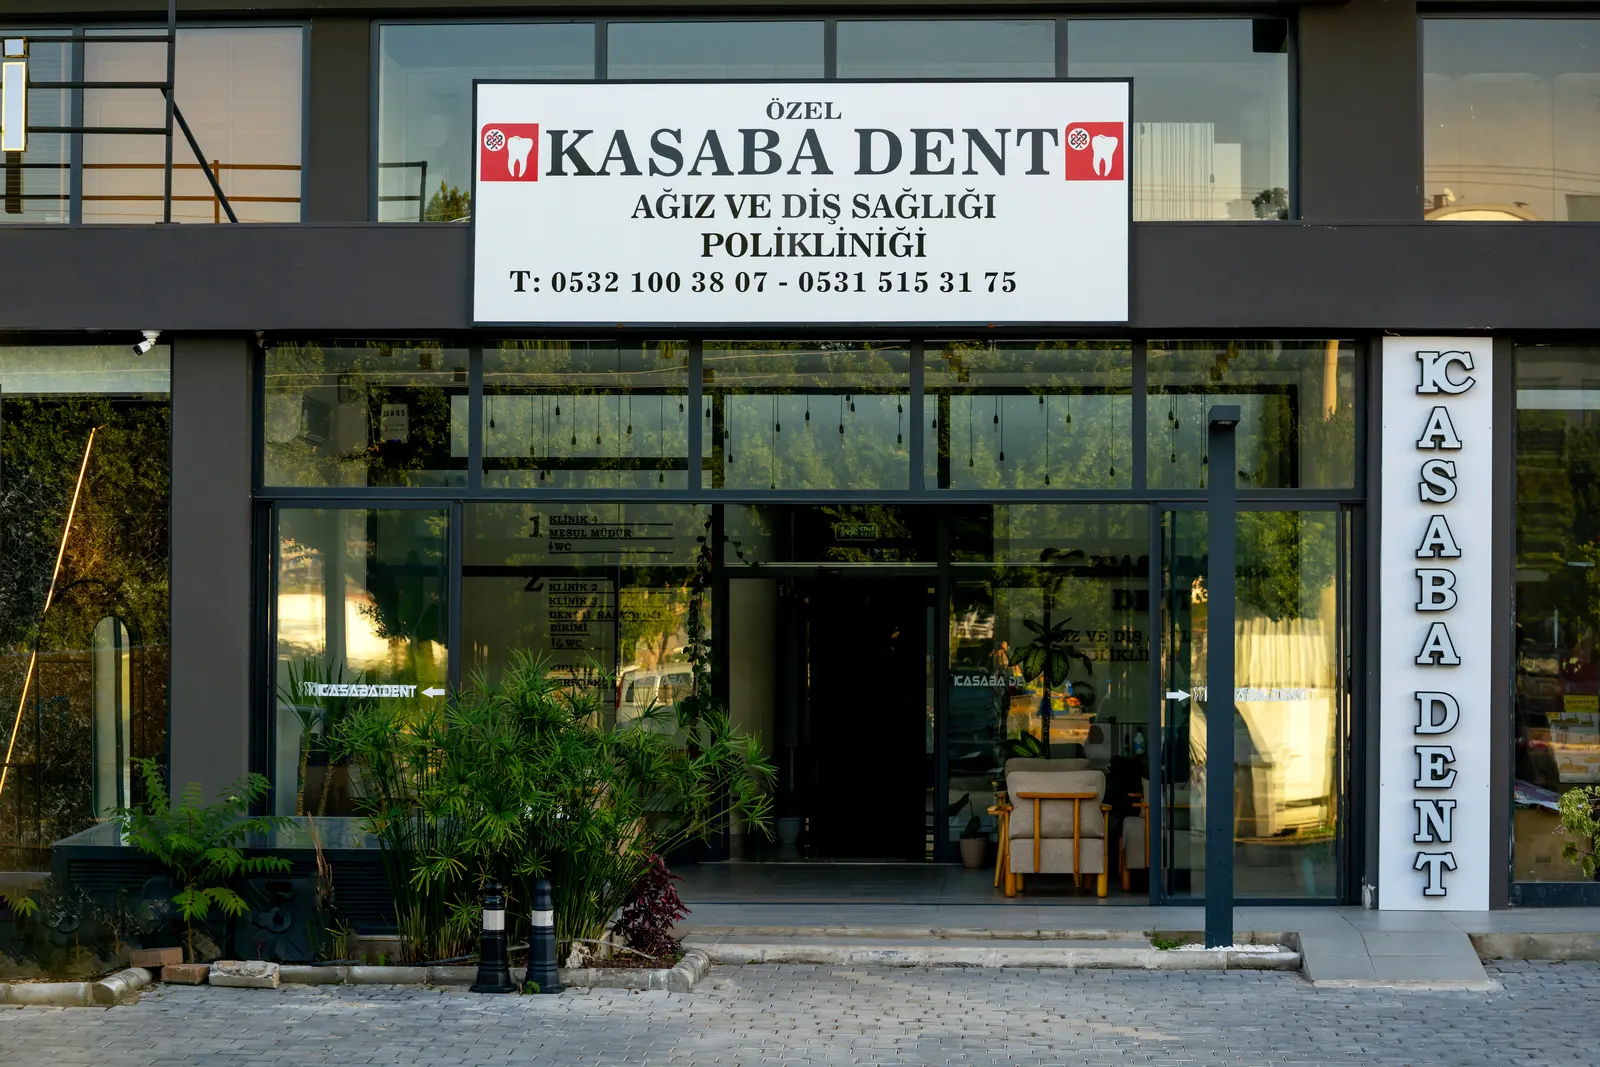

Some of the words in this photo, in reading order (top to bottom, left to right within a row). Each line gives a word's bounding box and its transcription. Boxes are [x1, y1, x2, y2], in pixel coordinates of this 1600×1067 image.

[767, 98, 842, 120] ÖZEL
[546, 128, 833, 177] KASABA
[854, 128, 1059, 176] DENT
[631, 188, 716, 219] AĞIZ
[724, 194, 772, 219] VE
[782, 187, 841, 225] DİŞ
[851, 187, 996, 219] SAĞLIĞI
[701, 226, 927, 258] POLİKLİNİĞİ
[509, 271, 540, 293] T:
[551, 271, 619, 293] 0532
[631, 271, 681, 293] 100
[692, 271, 725, 293] 38
[735, 271, 768, 293] 07
[799, 271, 867, 293] 0531
[879, 271, 929, 293] 515
[940, 271, 972, 293] 31
[984, 271, 1017, 293] 75
[549, 515, 588, 524] KLİNİK
[549, 529, 588, 538] MESUL
[590, 527, 632, 538] MÜDÜR
[554, 543, 572, 551] WC
[549, 582, 588, 591] KLİNİK
[1413, 690, 1460, 897] DENT
